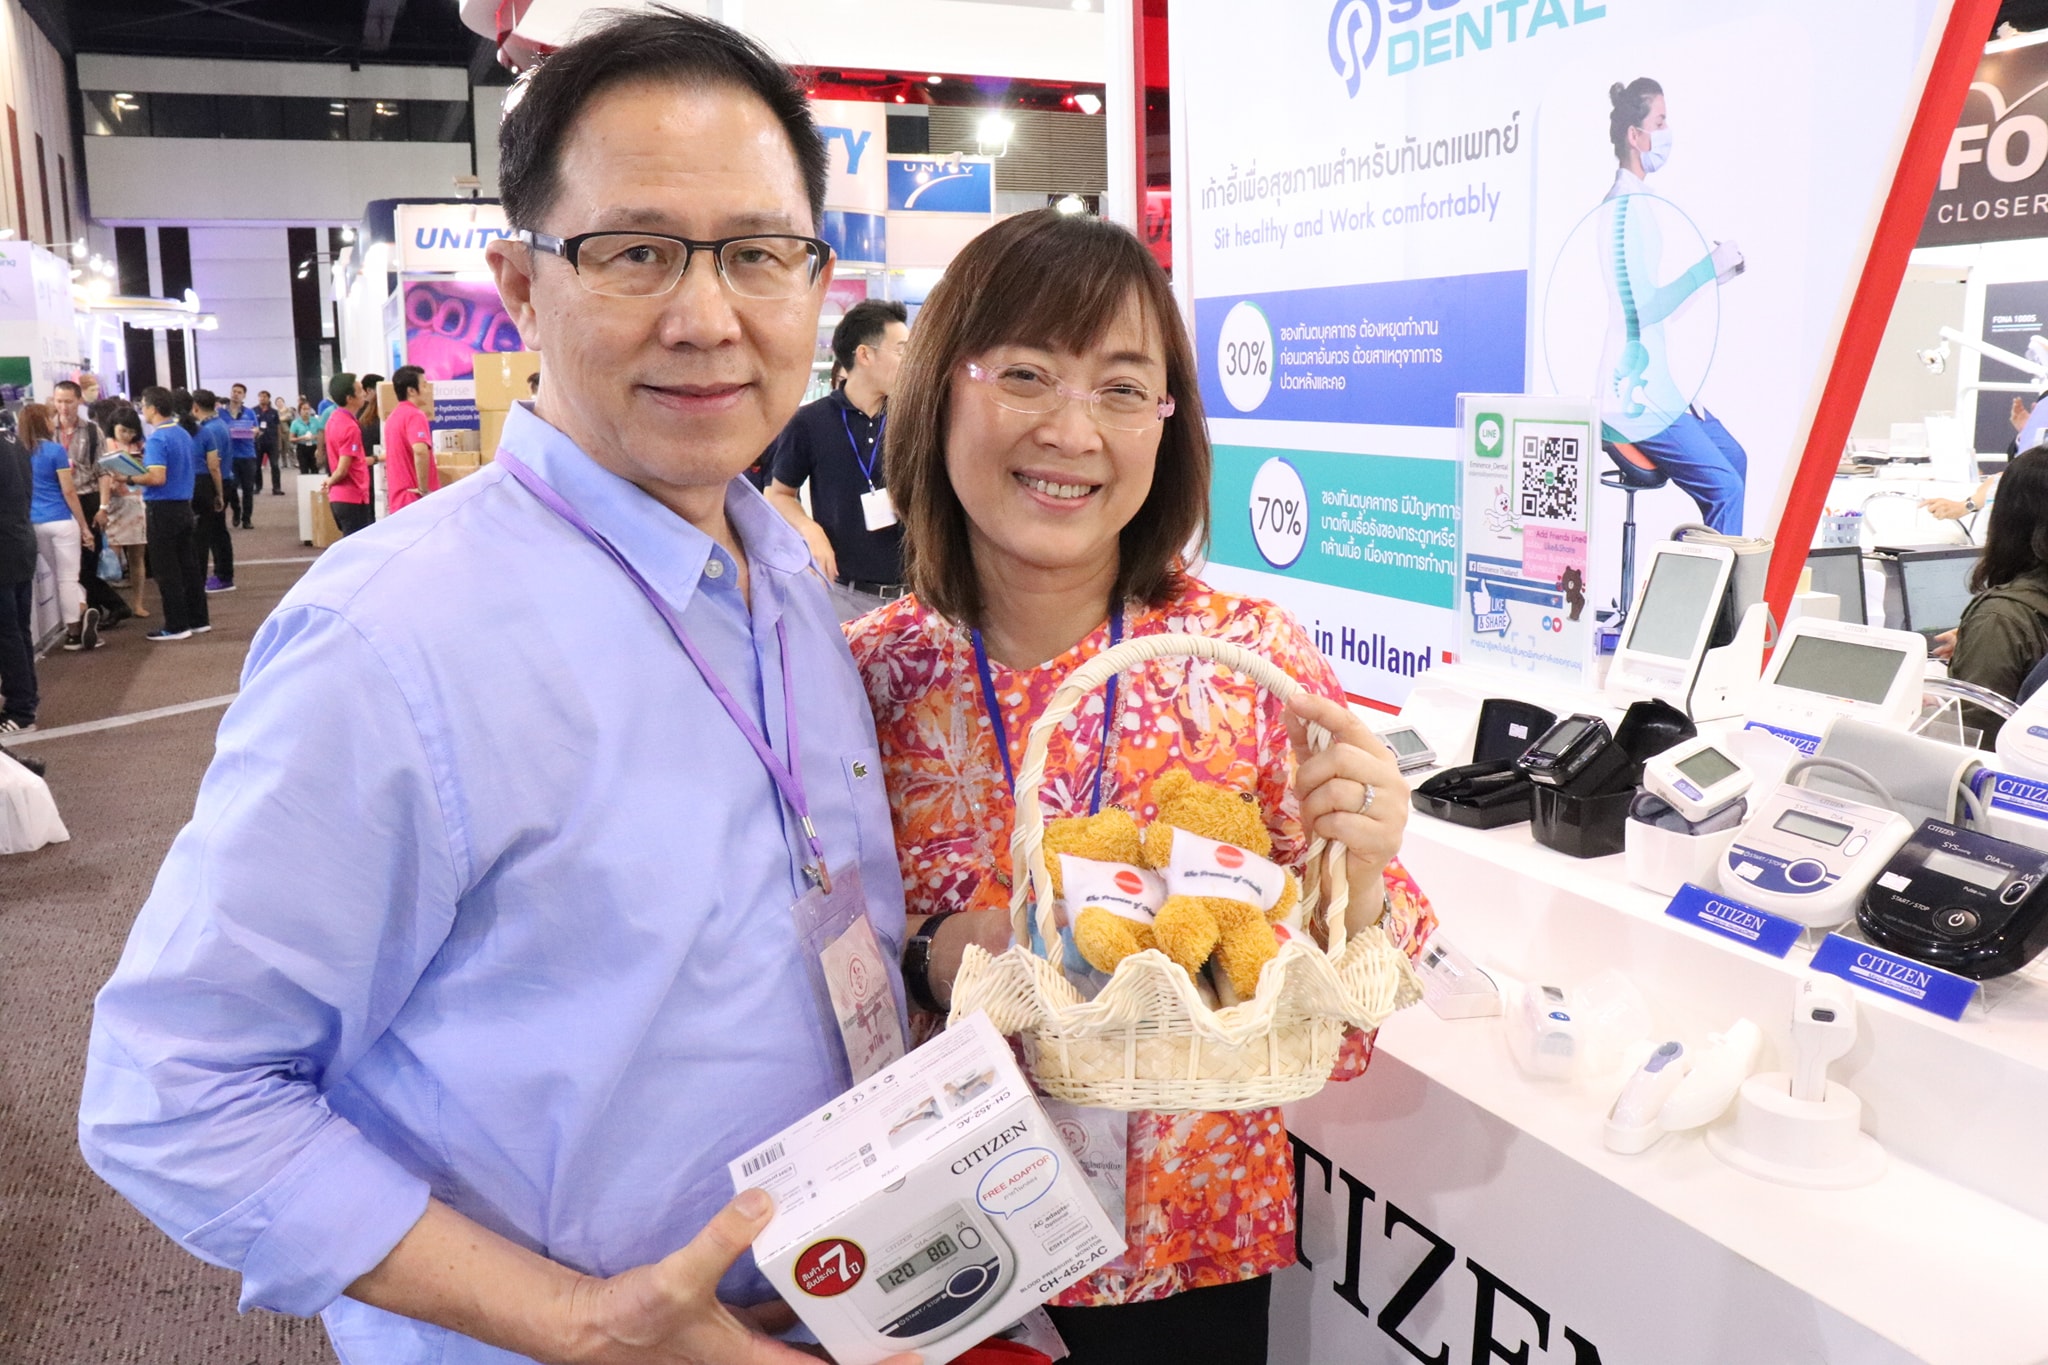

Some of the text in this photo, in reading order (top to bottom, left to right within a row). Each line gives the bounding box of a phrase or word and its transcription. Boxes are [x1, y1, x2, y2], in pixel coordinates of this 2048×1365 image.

[1387, 0, 1607, 76] DENTAL
[1201, 110, 1521, 210] เก้าอี้เพื่อสุขภาพสำหรับทันตแพทย์
[1213, 182, 1501, 250] Sit healthy and Work comfortably
[1937, 193, 2048, 224] CLOSER
[1280, 316, 1439, 344] ของทันตบุคลากร ต้องหยุดทำงาน
[1226, 340, 1268, 376] 30%
[1280, 346, 1443, 368] ก่อนเวลาอันควร ด้วยสาเหตุจากการ
[1280, 372, 1347, 390] ปวดหลังและคอ
[1482, 429, 1497, 439] LINE
[1321, 488, 1398, 514] ของทันตบุคลากร
[1258, 496, 1302, 537] 70%
[1535, 530, 1548, 540] Add
[1321, 536, 1361, 560] กล้ามเนื้อ
[1492, 597, 1505, 612] LIKE
[1479, 615, 1507, 629] & SHARE
[1315, 619, 1431, 678] in Holland
[1927, 824, 1957, 837] CITIZEN
[1941, 841, 1960, 851] SYS
[1984, 854, 2001, 864] DIA
[2021, 873, 2034, 883] M
[1890, 894, 1911, 906] START
[1913, 901, 1931, 912] STOP
[1705, 900, 1767, 931] CITIZEN
[1856, 952, 1933, 989] CITIZEN
[957, 1090, 1011, 1129] CH-452-AC
[951, 1120, 1028, 1175] CITIZEN
[982, 1183, 1008, 1201] FREE
[1008, 1154, 1052, 1186] ADAPTOR
[1033, 1220, 1044, 1229] AC
[1044, 1211, 1069, 1229] Optional
[914, 1238, 929, 1249] DIA
[926, 1240, 951, 1262] 80
[1048, 1240, 1062, 1252] ESH
[1075, 1234, 1098, 1251] DIGITAL
[1286, 1130, 1604, 1365] TIZE
[802, 1265, 821, 1282] สินค้า
[818, 1243, 851, 1283] 7
[849, 1261, 861, 1275] ปี
[888, 1263, 916, 1287] 120
[1020, 1239, 1103, 1293] BLOOD PRESSURE MONITOR
[1039, 1245, 1108, 1293] CH-452-AC
[806, 1266, 837, 1290] รับประกัน
[904, 1308, 923, 1321] START
